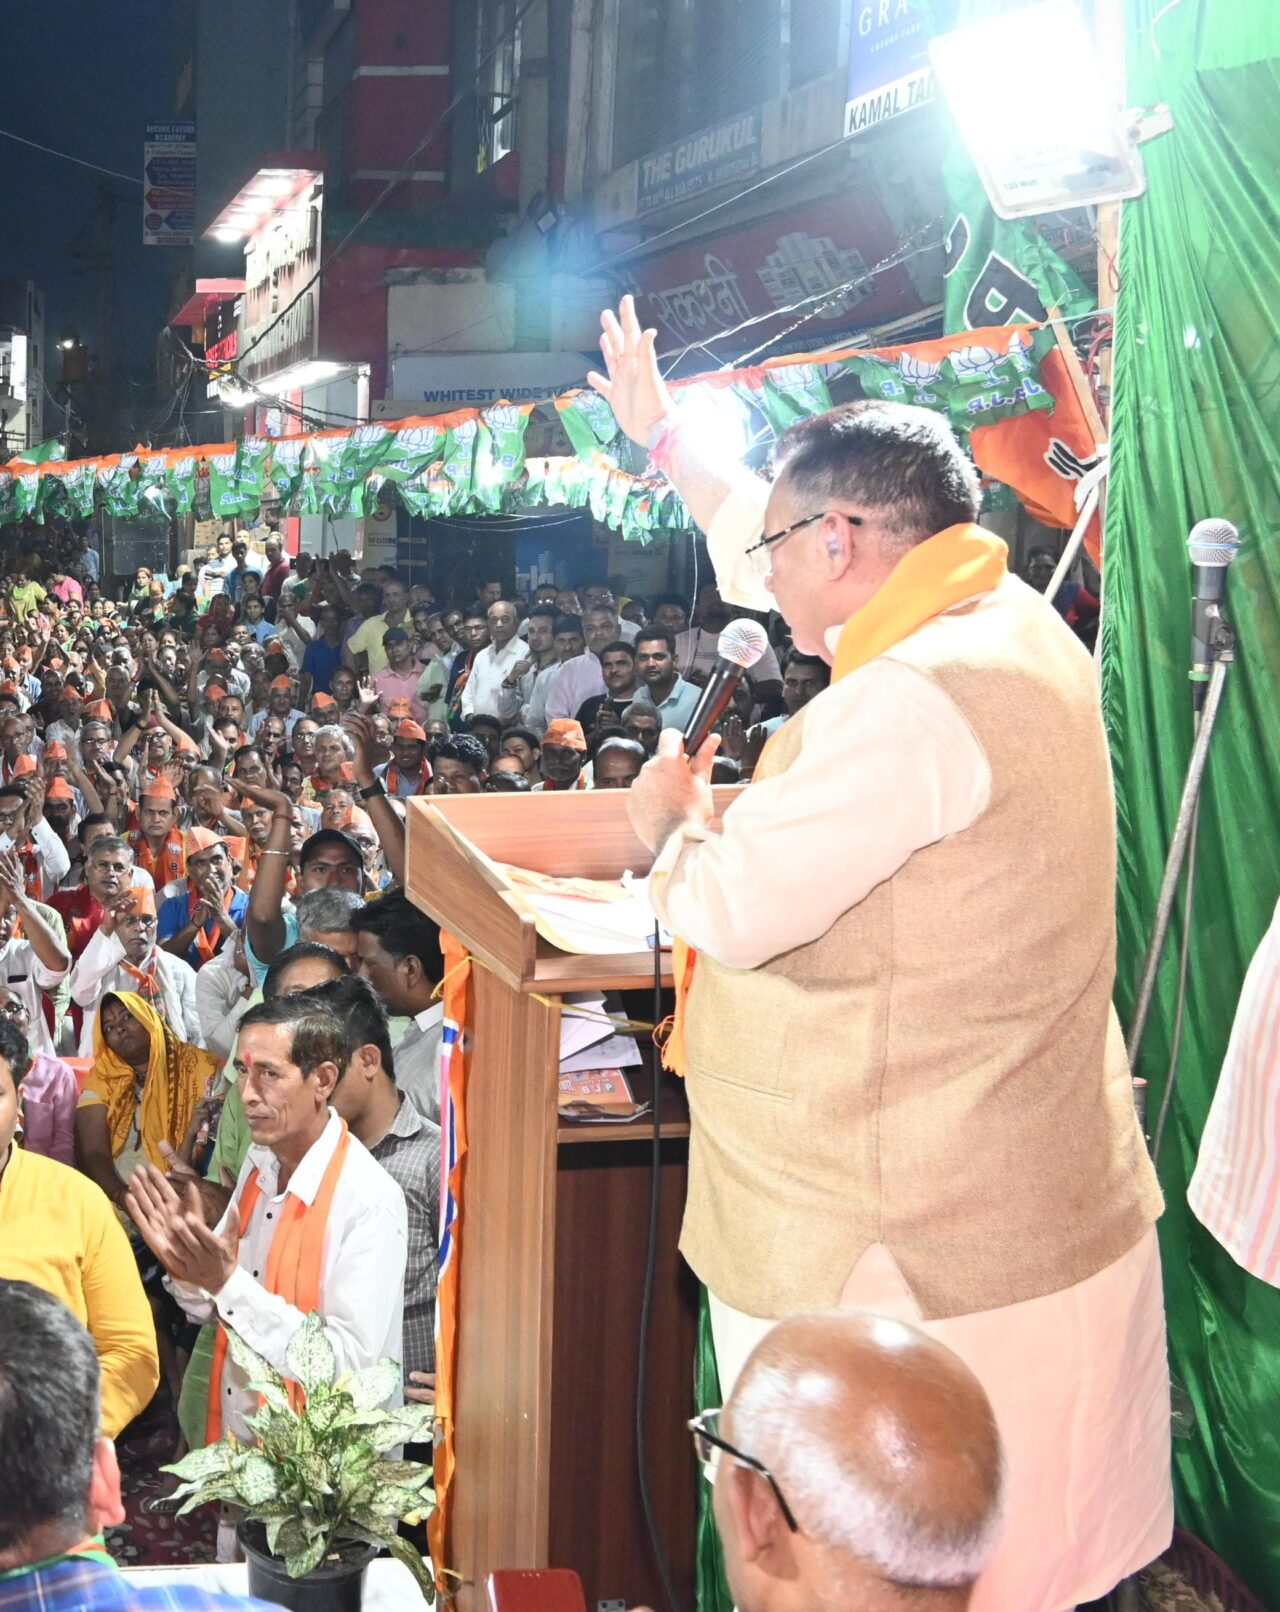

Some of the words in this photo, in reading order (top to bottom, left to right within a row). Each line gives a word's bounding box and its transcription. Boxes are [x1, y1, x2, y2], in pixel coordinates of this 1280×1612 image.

[849, 88, 901, 133] KAMAL
[642, 155, 672, 187] THE
[424, 388, 495, 402] WHITEST
[500, 386, 542, 400] WIDE
